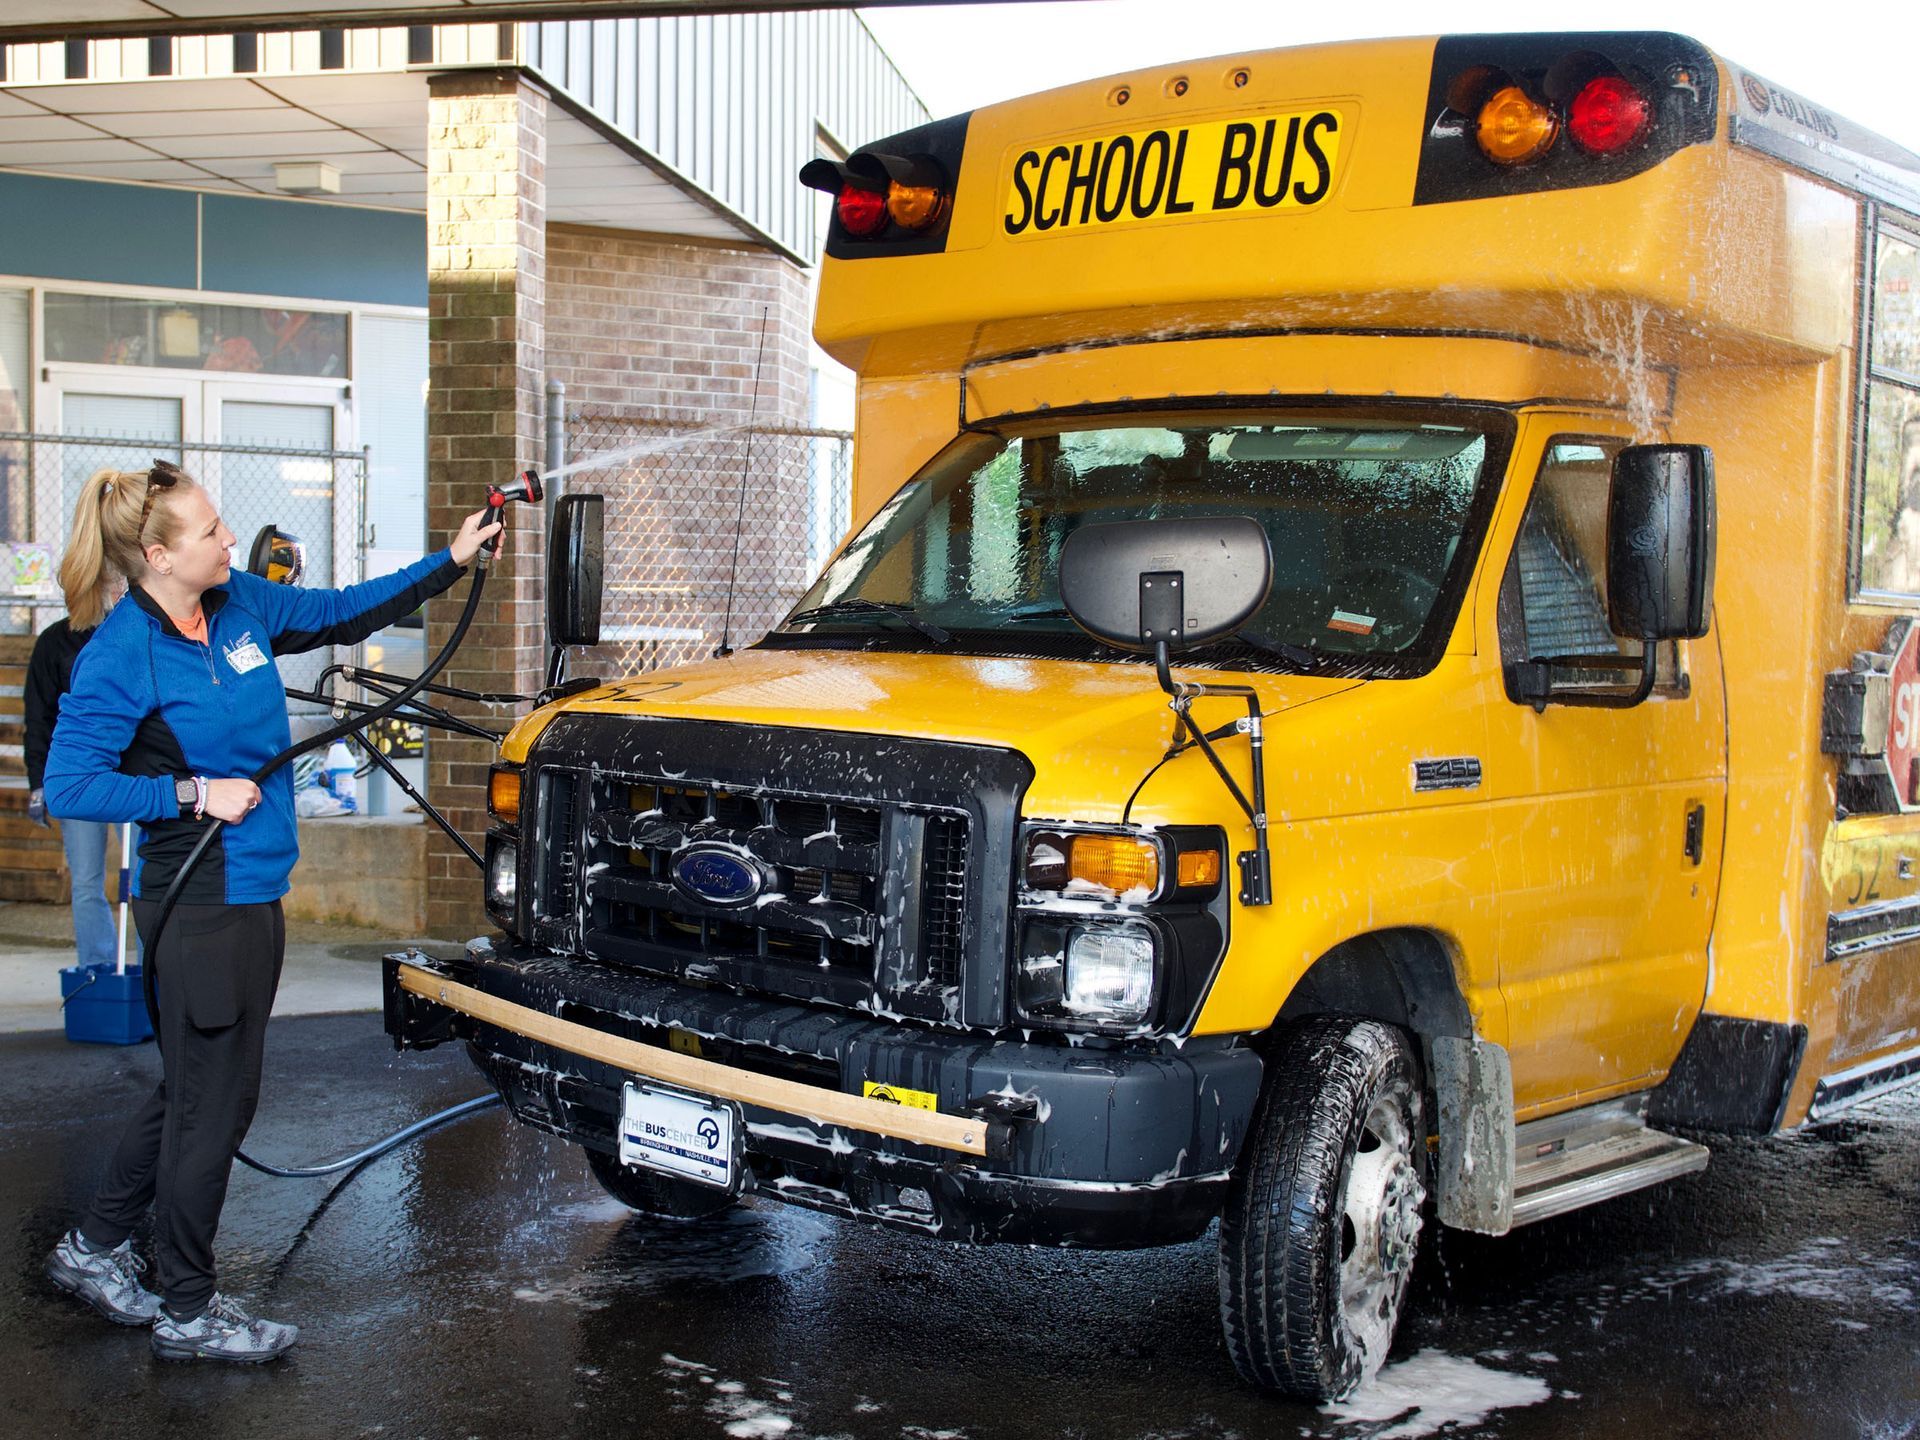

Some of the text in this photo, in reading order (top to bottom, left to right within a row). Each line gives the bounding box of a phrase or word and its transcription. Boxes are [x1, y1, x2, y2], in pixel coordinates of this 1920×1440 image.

[1769, 88, 1838, 140] COLLINS
[1004, 112, 1339, 235] SCHOOL BUS
